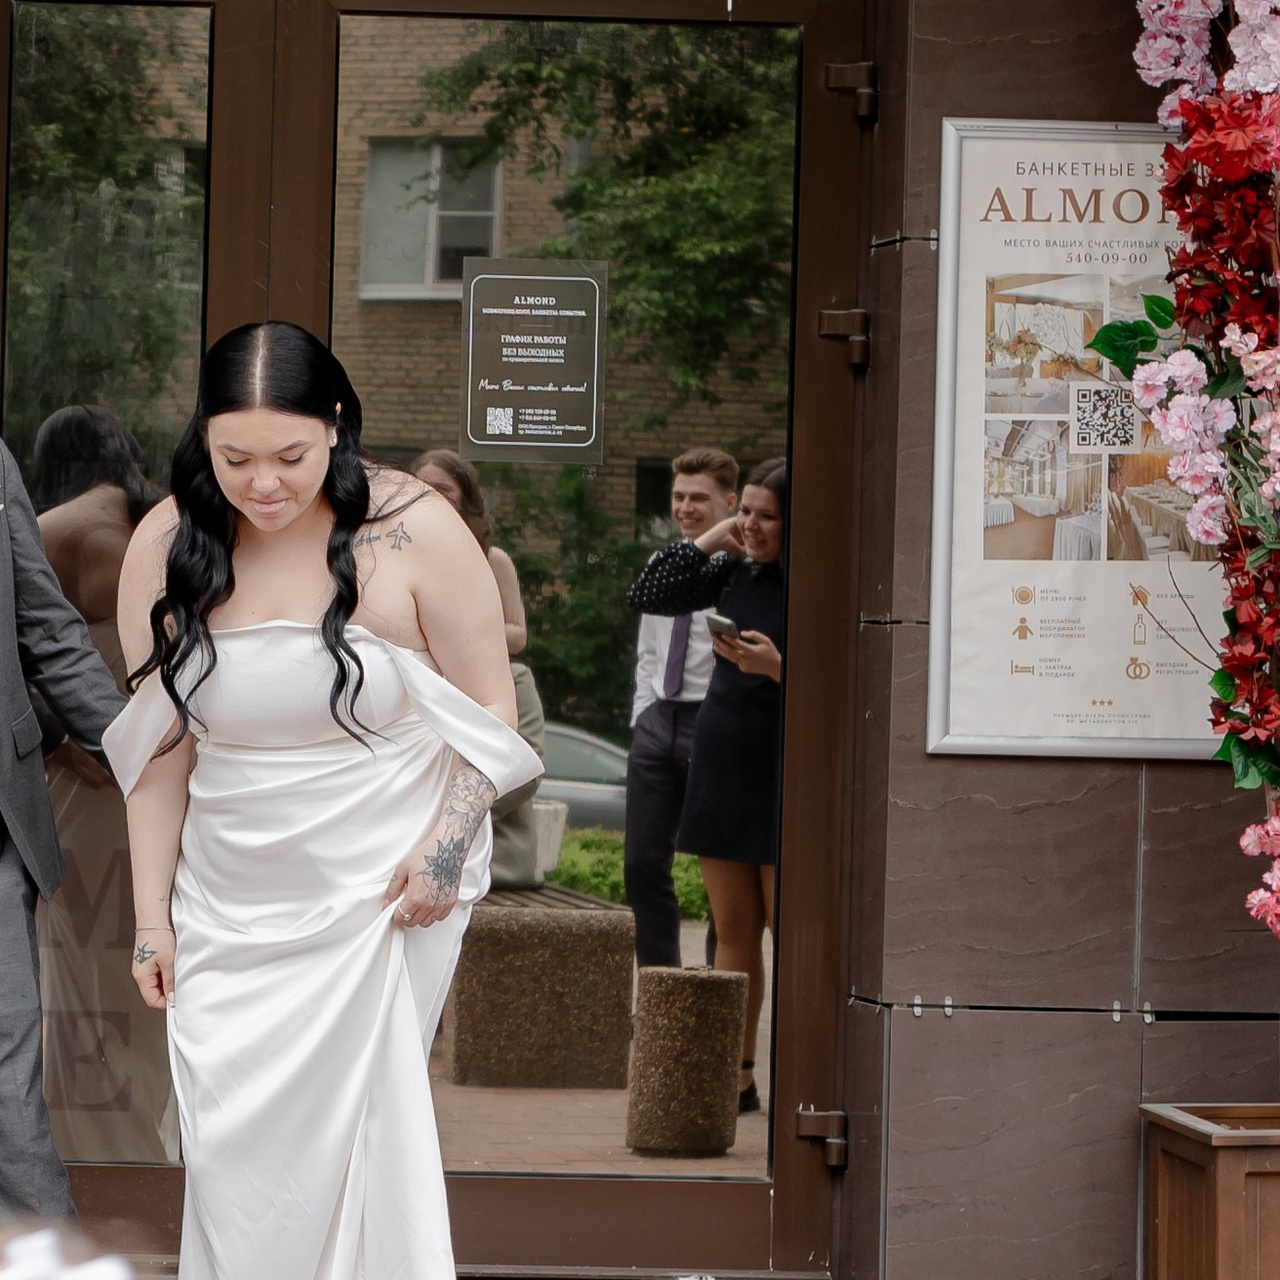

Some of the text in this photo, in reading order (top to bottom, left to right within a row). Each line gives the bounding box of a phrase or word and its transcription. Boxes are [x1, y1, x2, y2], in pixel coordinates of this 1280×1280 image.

[1016, 161, 1135, 176] БАНКЕТНЫЕ
[1004, 238, 1041, 248] МЕСТО
[1045, 239, 1084, 248] ВАШИХ
[1088, 240, 1160, 249] СЧАСТЛИВЫХ
[1066, 252, 1148, 264] 540-09-00
[513, 296, 556, 306] ALMOND
[501, 334, 567, 345] ГРАФИК РАБОТЫ
[502, 347, 565, 357] БЕЗ ВЫХОДНЫХ
